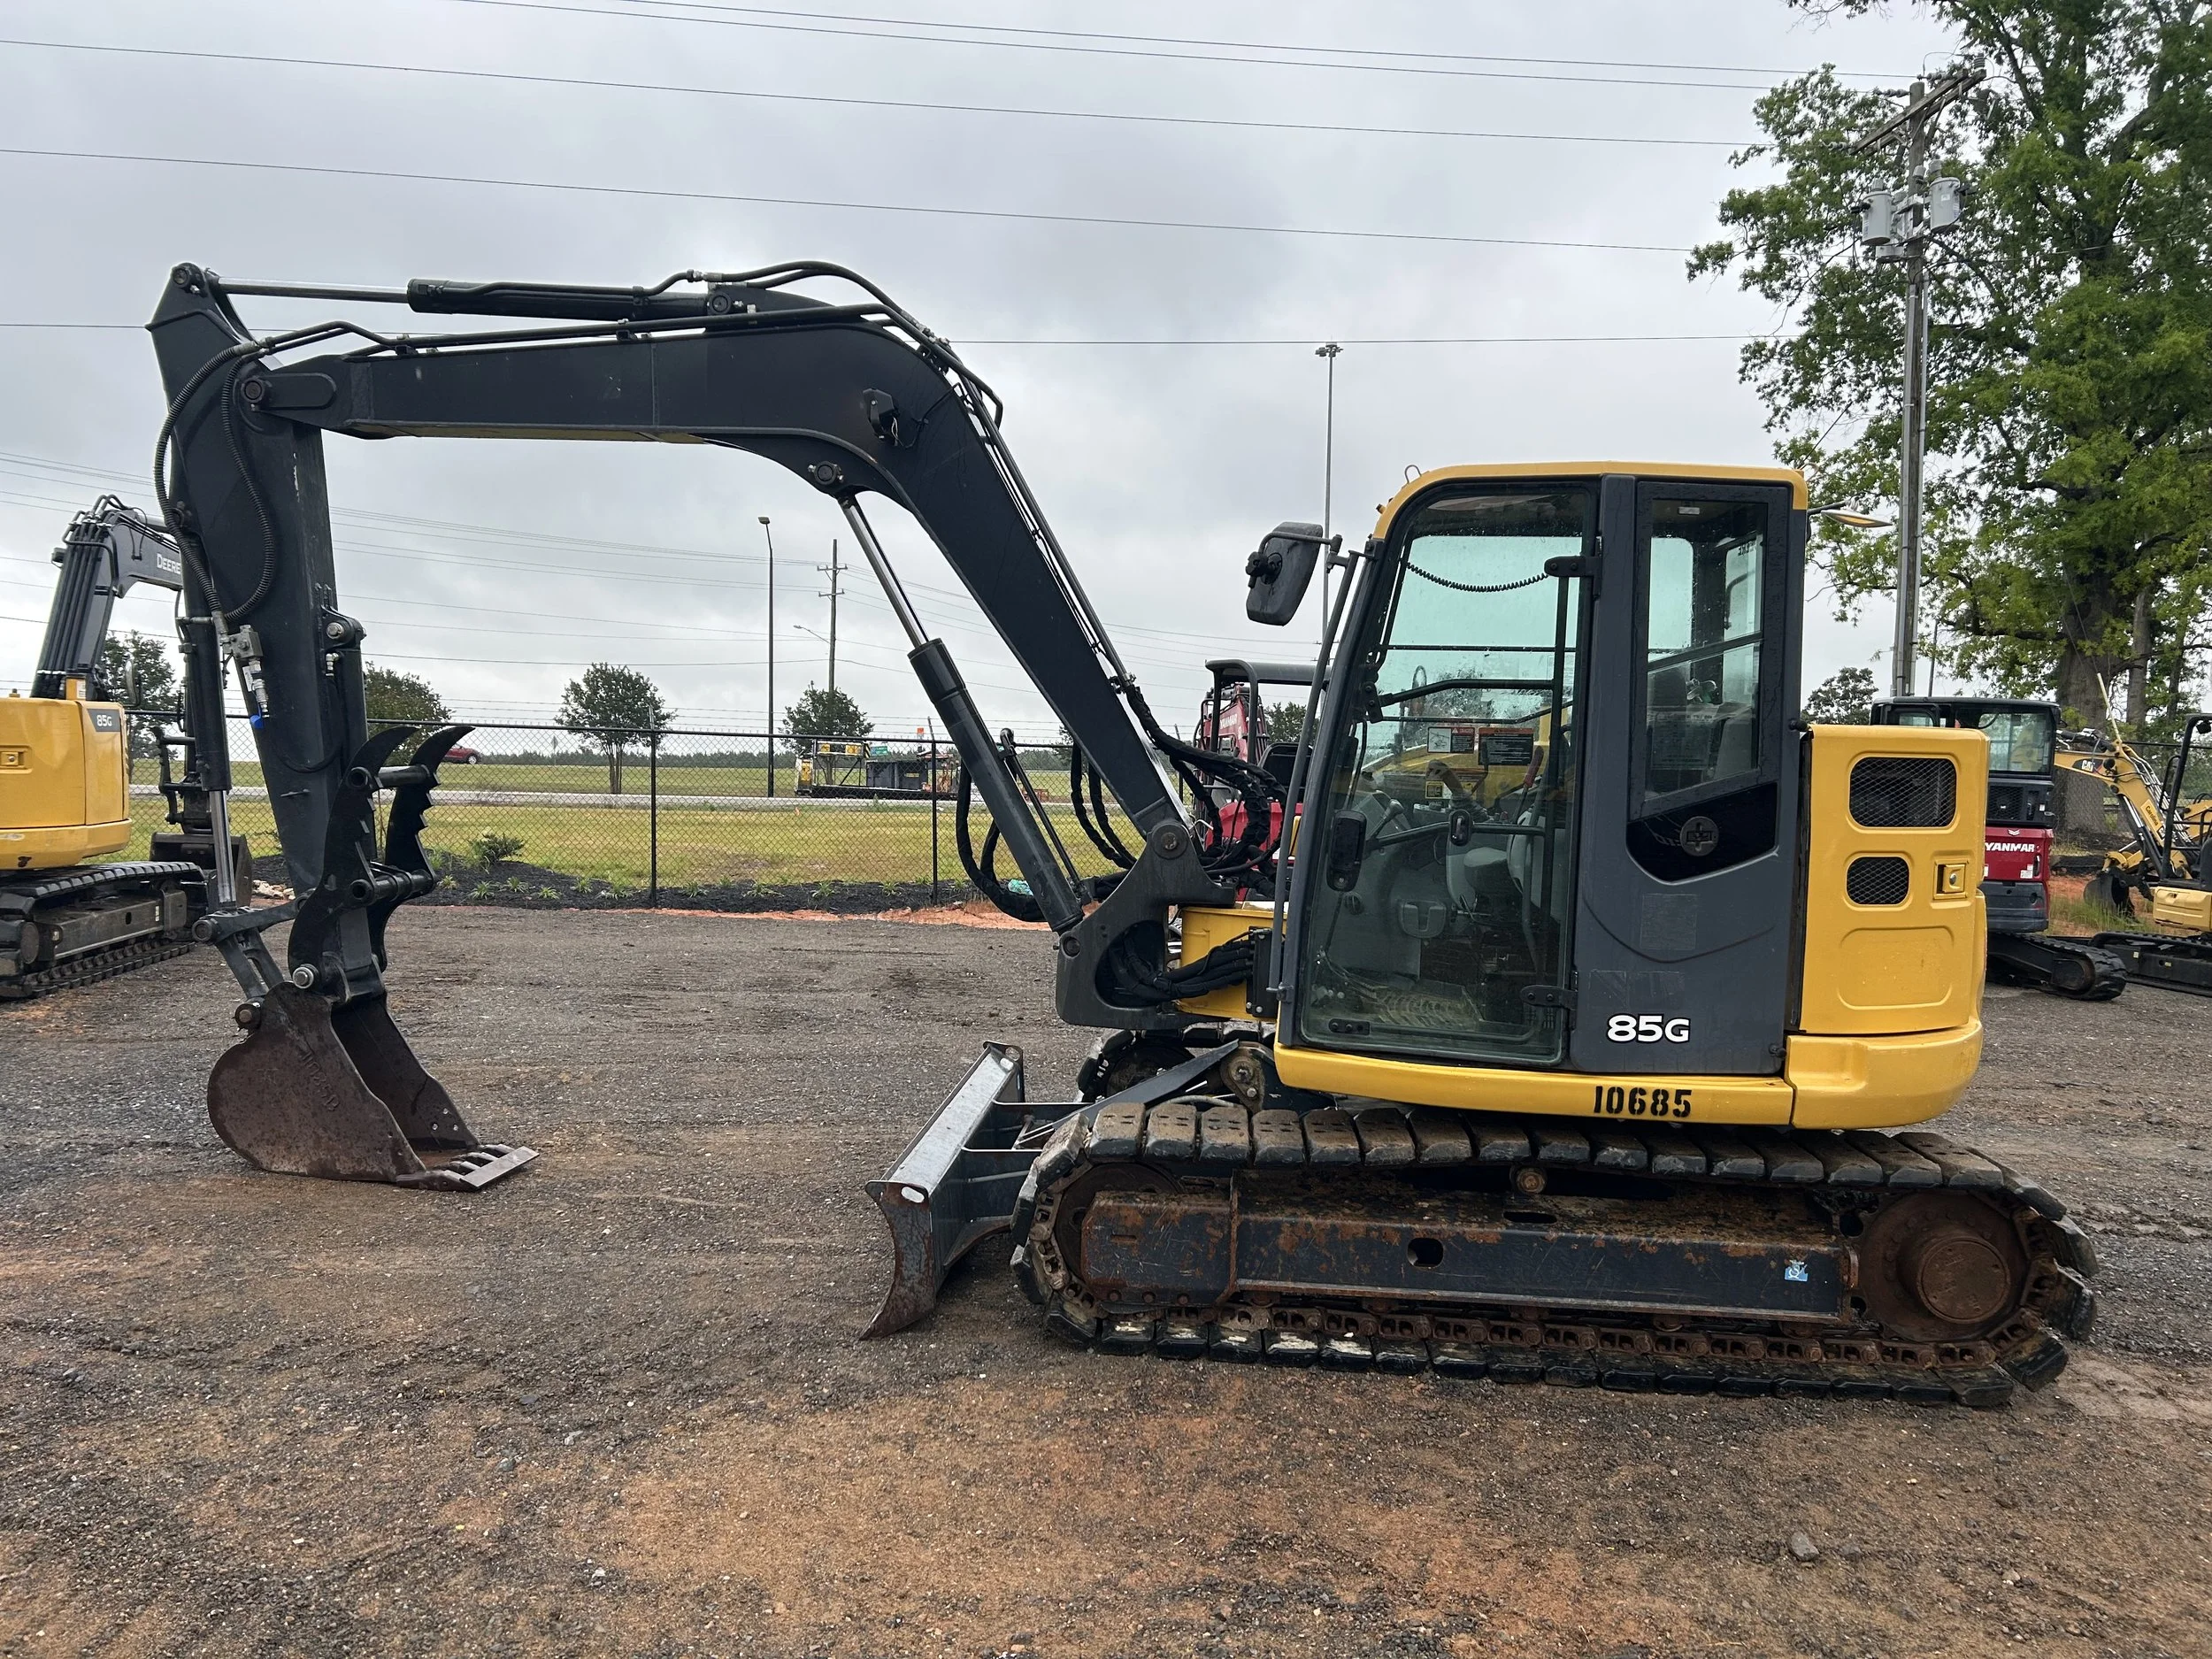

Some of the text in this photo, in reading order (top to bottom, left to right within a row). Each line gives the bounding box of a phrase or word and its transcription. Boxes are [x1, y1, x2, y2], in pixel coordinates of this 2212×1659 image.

[157, 553, 181, 575] DEERE
[96, 714, 112, 727] 85G
[1985, 842, 2035, 853] YANMAR
[1607, 1014, 1691, 1043] 85G
[1594, 1086, 1692, 1118] 10685
